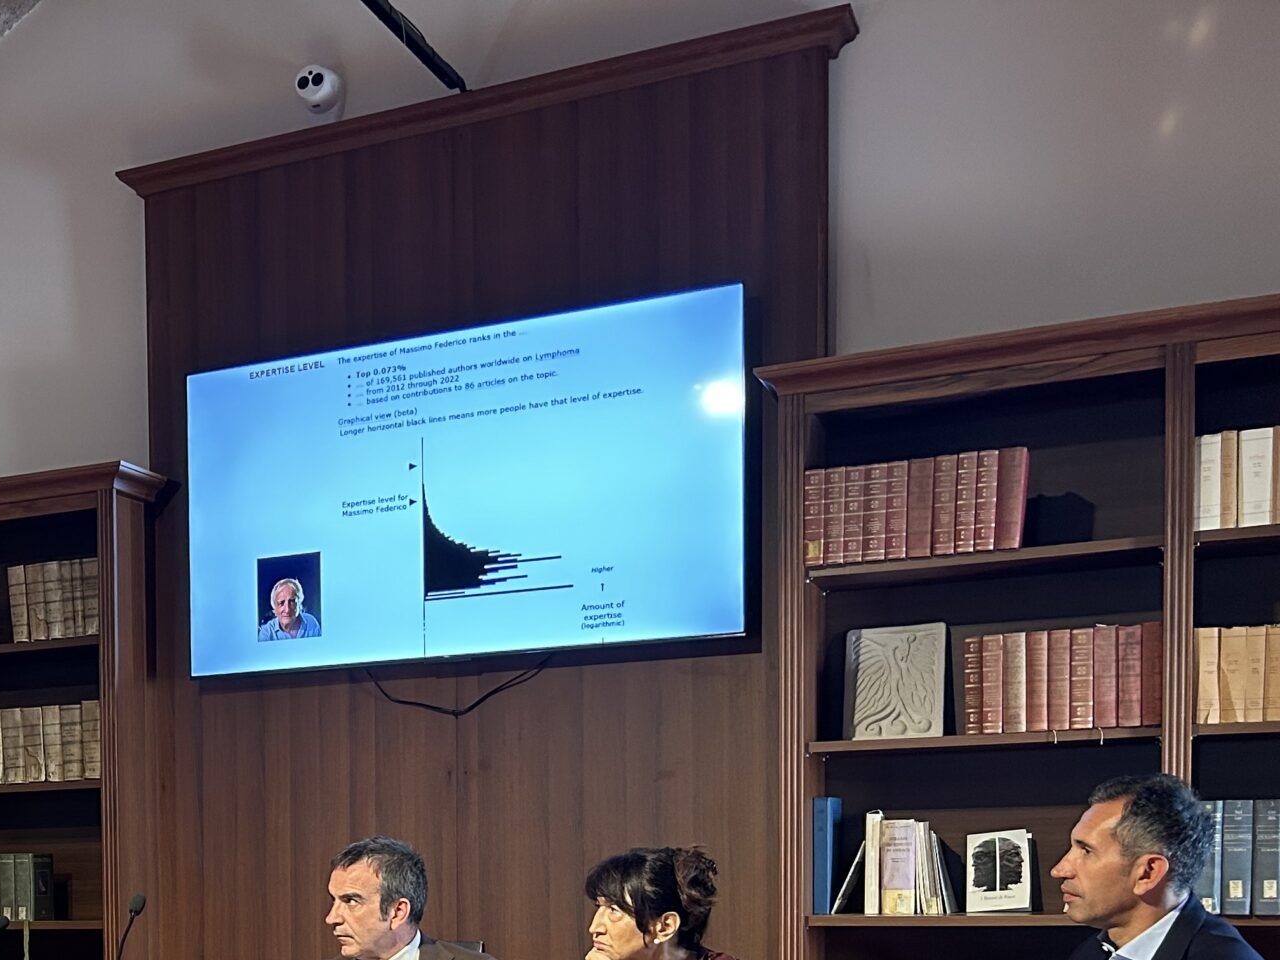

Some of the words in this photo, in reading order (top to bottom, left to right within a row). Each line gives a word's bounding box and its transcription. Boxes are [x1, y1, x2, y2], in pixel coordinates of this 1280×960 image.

[338, 357, 351, 365] The
[353, 351, 388, 362] expertise
[390, 348, 398, 356] of
[400, 344, 432, 354] Massimo
[434, 338, 467, 349] Federico
[470, 333, 490, 344] ranks
[504, 330, 516, 338] the
[249, 364, 295, 380] EXPERTISE
[298, 361, 325, 372] LEVEL
[356, 370, 370, 379] Top
[373, 364, 406, 376] 0.073%
[366, 379, 374, 387] of
[409, 368, 446, 381] published
[448, 362, 478, 374] authors
[480, 356, 520, 369] worldwide
[522, 354, 532, 362] on
[536, 347, 580, 362] Lymphoma
[366, 386, 384, 396] from
[386, 384, 405, 393] 2012
[408, 378, 438, 390] through
[440, 375, 460, 385] 2022
[366, 394, 388, 405] based
[402, 386, 452, 400] contributions
[454, 384, 462, 392] to
[464, 382, 475, 390] 86
[477, 376, 506, 388] articles
[508, 376, 518, 384] on
[520, 372, 534, 381] the
[536, 368, 558, 380] topic.
[338, 410, 372, 426] Graphical
[375, 412, 392, 421] view
[394, 407, 418, 419] (beta)
[340, 426, 364, 438] Longer
[367, 420, 404, 432] horizontal
[406, 417, 426, 427] black
[428, 414, 446, 424] lines
[448, 411, 474, 420] means
[476, 408, 497, 416] more
[500, 403, 526, 415] people
[528, 400, 548, 409] have
[550, 396, 568, 406] that
[570, 394, 590, 403] level
[592, 392, 600, 400] of
[602, 386, 644, 399] expertise.
[342, 499, 375, 508] Expertise
[378, 495, 395, 503] level
[342, 508, 374, 516] Massimo
[376, 504, 406, 512] Federico
[581, 602, 614, 611] Amount
[616, 600, 624, 608] of
[584, 612, 622, 621] expertise
